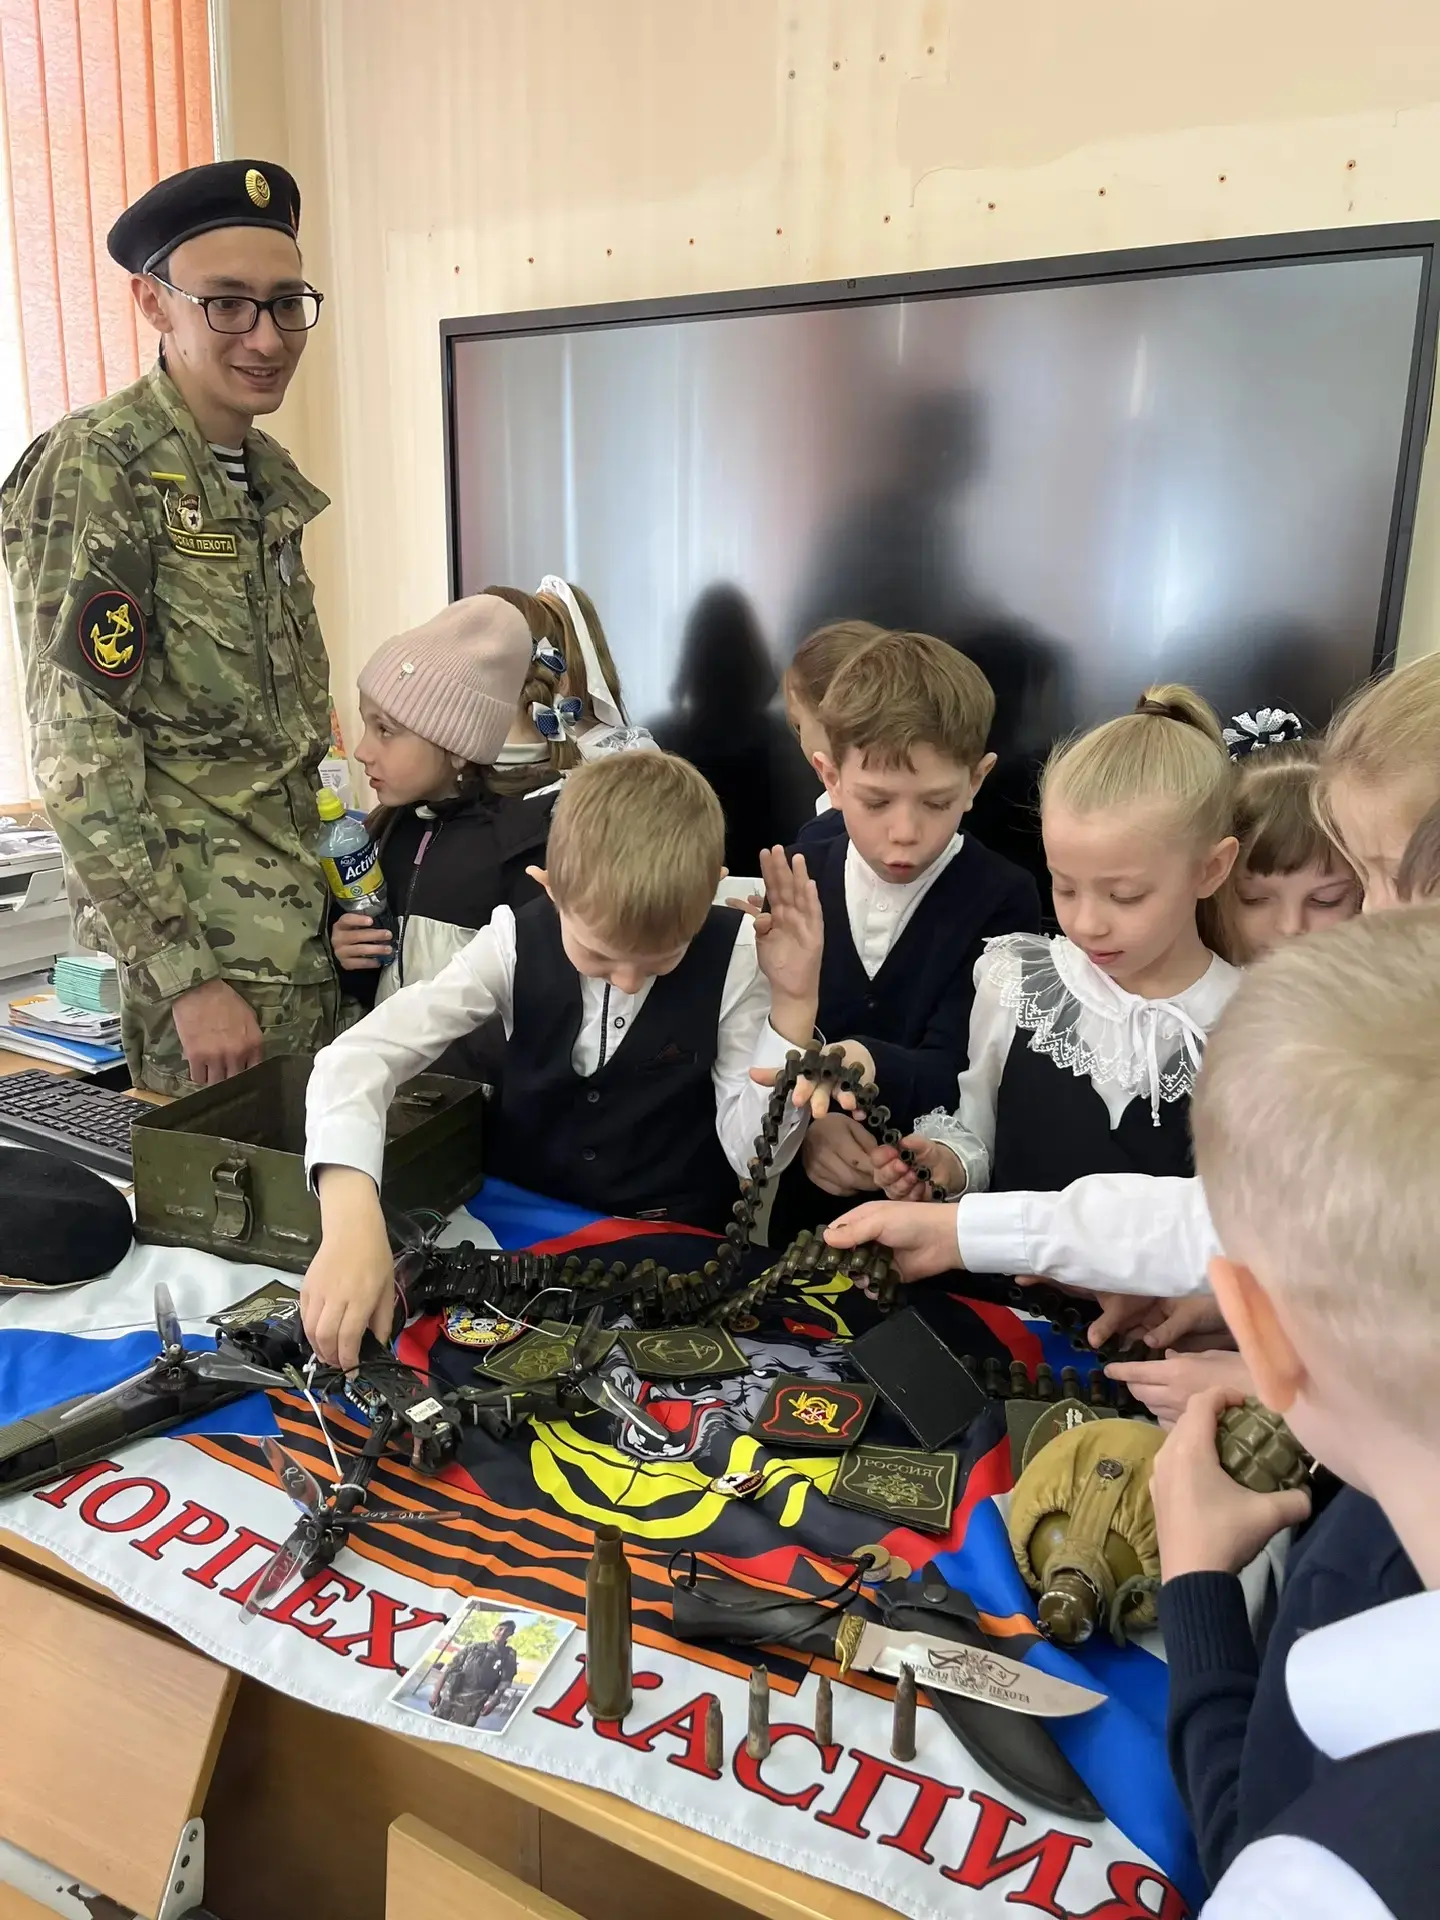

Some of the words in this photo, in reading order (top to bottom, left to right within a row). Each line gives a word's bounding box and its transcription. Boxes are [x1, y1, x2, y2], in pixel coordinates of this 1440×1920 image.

[197, 540, 233, 551] ПЕХОТА
[864, 1458, 934, 1478] РОССИЯ
[988, 1684, 1031, 1704] ПЕХОТА
